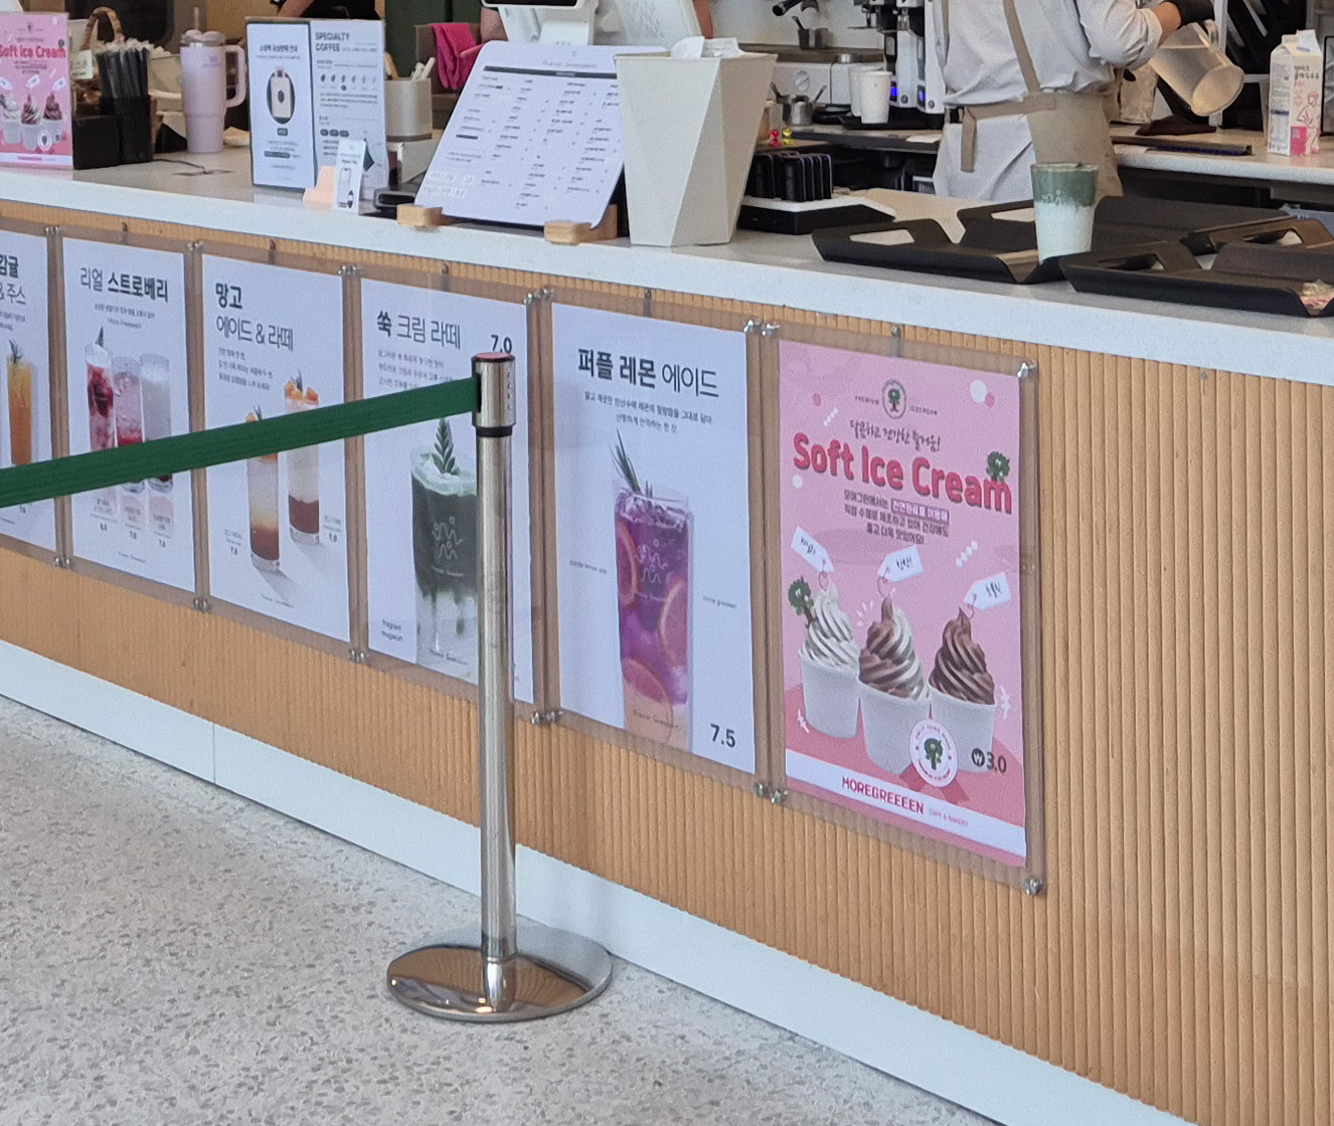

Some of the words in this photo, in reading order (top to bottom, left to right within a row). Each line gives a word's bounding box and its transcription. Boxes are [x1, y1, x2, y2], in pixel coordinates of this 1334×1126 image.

[36, 45, 66, 58] Cream
[7, 283, 26, 305] 주스
[81, 268, 102, 292] 리얼
[108, 273, 168, 302] 스트로베리
[216, 283, 242, 309] 망고
[216, 316, 253, 342] 에이드
[256, 323, 265, 344] &
[268, 325, 293, 351] 라떼
[377, 311, 392, 337] 쑥
[397, 315, 425, 343] 크림
[431, 321, 460, 349] 라떼
[491, 334, 513, 354] 7.0
[579, 349, 613, 380] 퍼플
[620, 356, 656, 388] 레몬
[662, 364, 719, 397] 에이드
[793, 433, 854, 482] Soft
[862, 445, 904, 491] Ice
[913, 454, 1011, 517] Cream
[711, 724, 735, 748] 7.5
[839, 774, 927, 818] MOREGREEEEN
